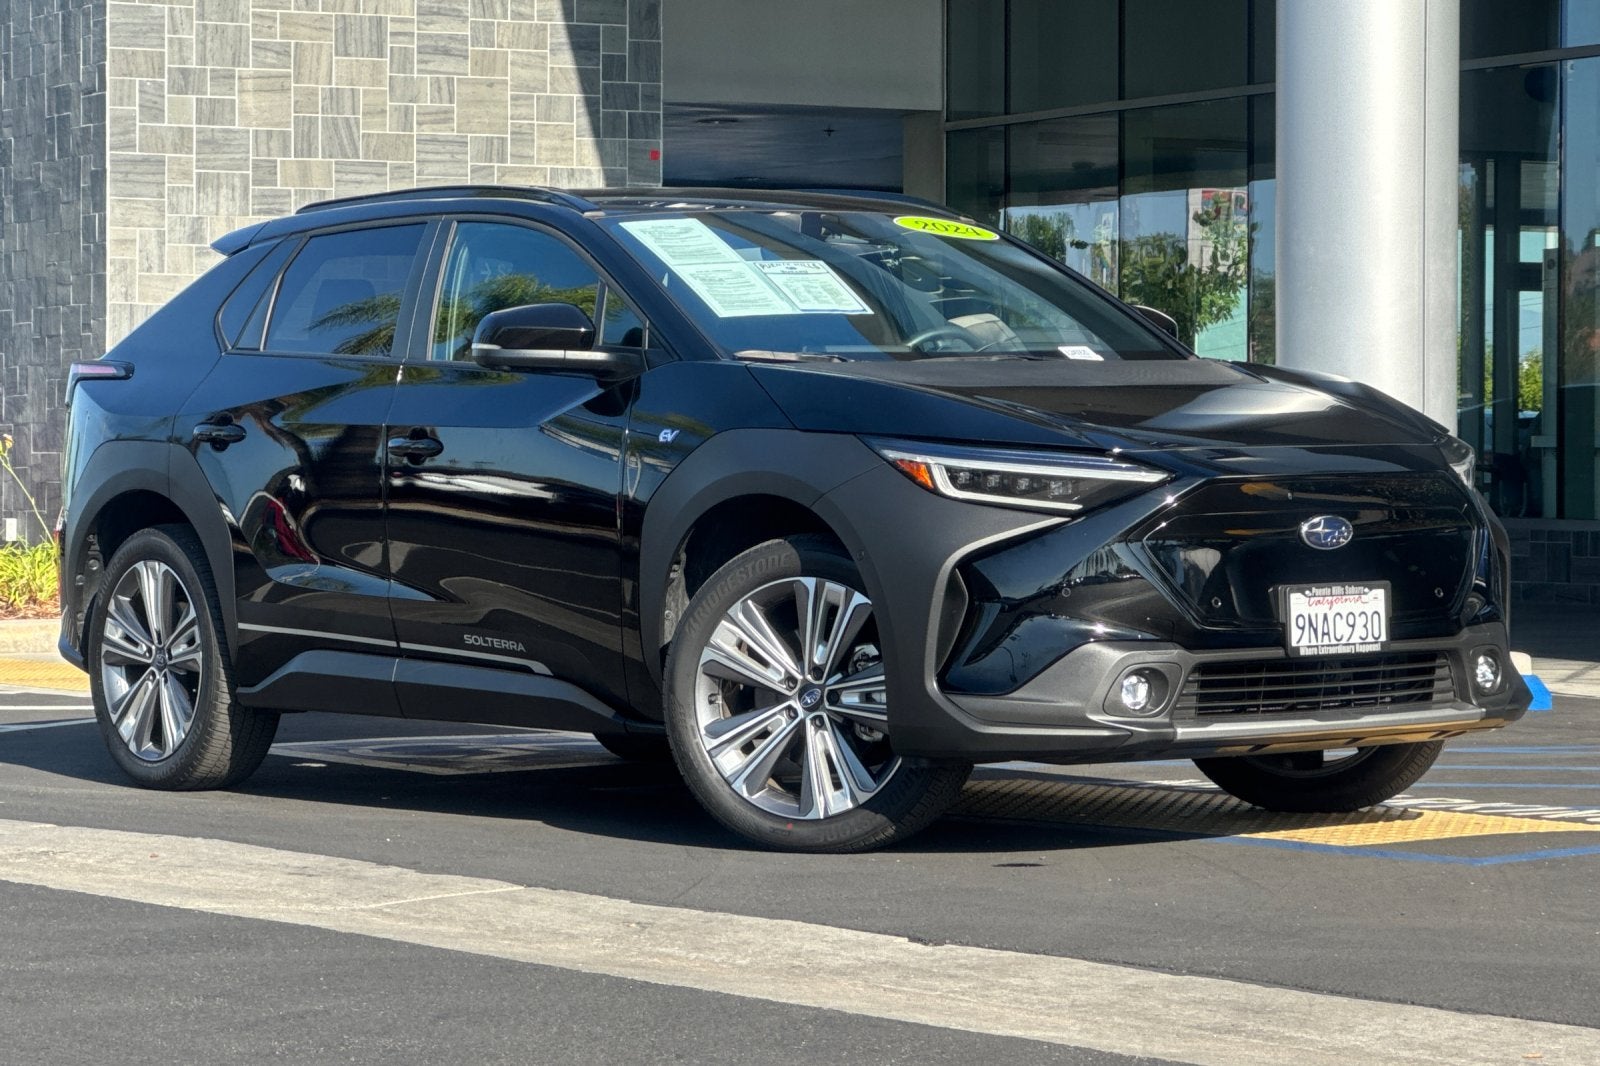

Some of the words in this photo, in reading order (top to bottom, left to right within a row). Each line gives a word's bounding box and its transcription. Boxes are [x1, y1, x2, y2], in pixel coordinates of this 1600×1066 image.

[914, 220, 981, 236] 2024
[1312, 587, 1331, 596] Puente
[1331, 586, 1344, 595] Hills
[1345, 585, 1364, 595] Subaru
[1308, 595, 1369, 610] California
[1295, 611, 1381, 644] 9NAC930
[463, 634, 526, 652] SOLTERRA
[1300, 646, 1318, 656] Where
[1318, 644, 1355, 654] Extraordinary
[1355, 642, 1381, 653] Happens!
